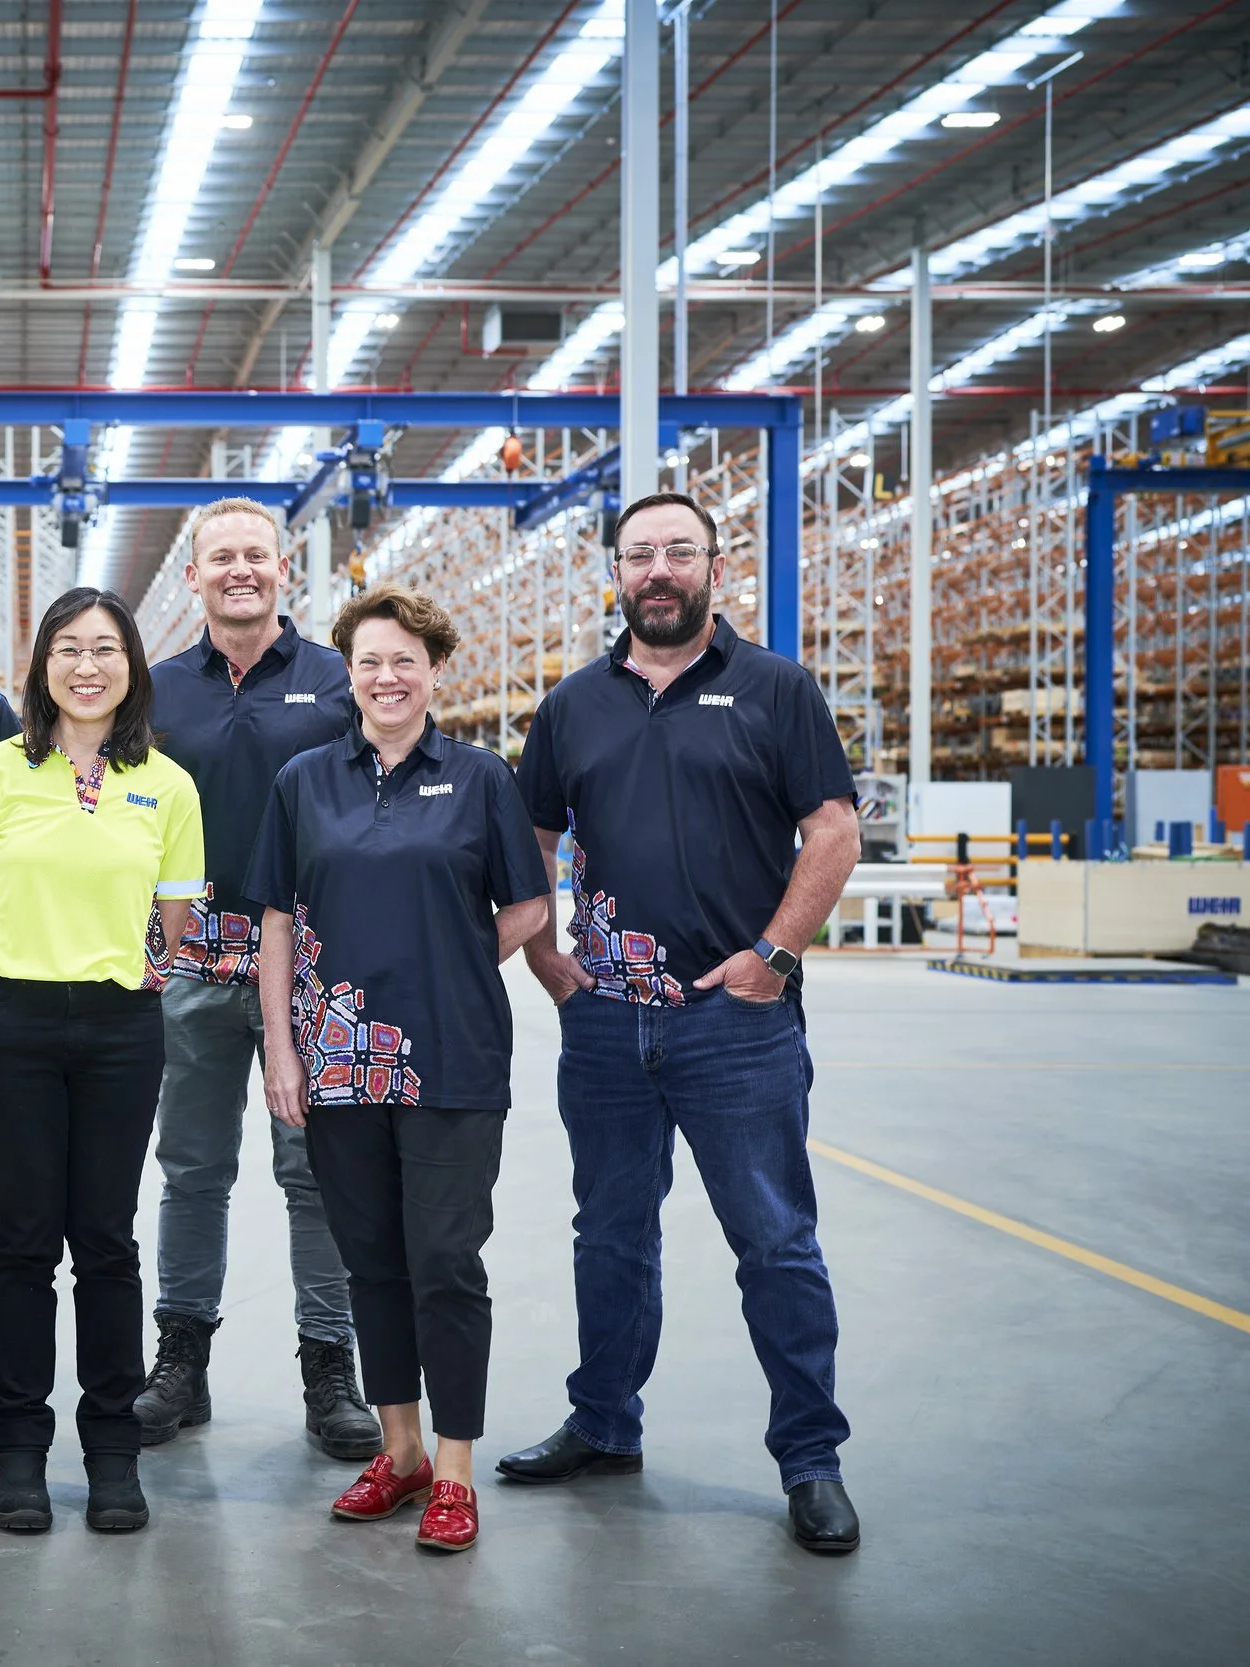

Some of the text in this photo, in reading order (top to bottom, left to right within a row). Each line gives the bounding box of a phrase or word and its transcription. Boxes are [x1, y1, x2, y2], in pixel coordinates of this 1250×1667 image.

[874, 472, 894, 499] L
[285, 693, 316, 704] WEIR
[699, 693, 735, 707] WEIR
[419, 783, 453, 796] WEIR
[127, 793, 158, 809] WEIR
[1187, 898, 1241, 915] WEIR
